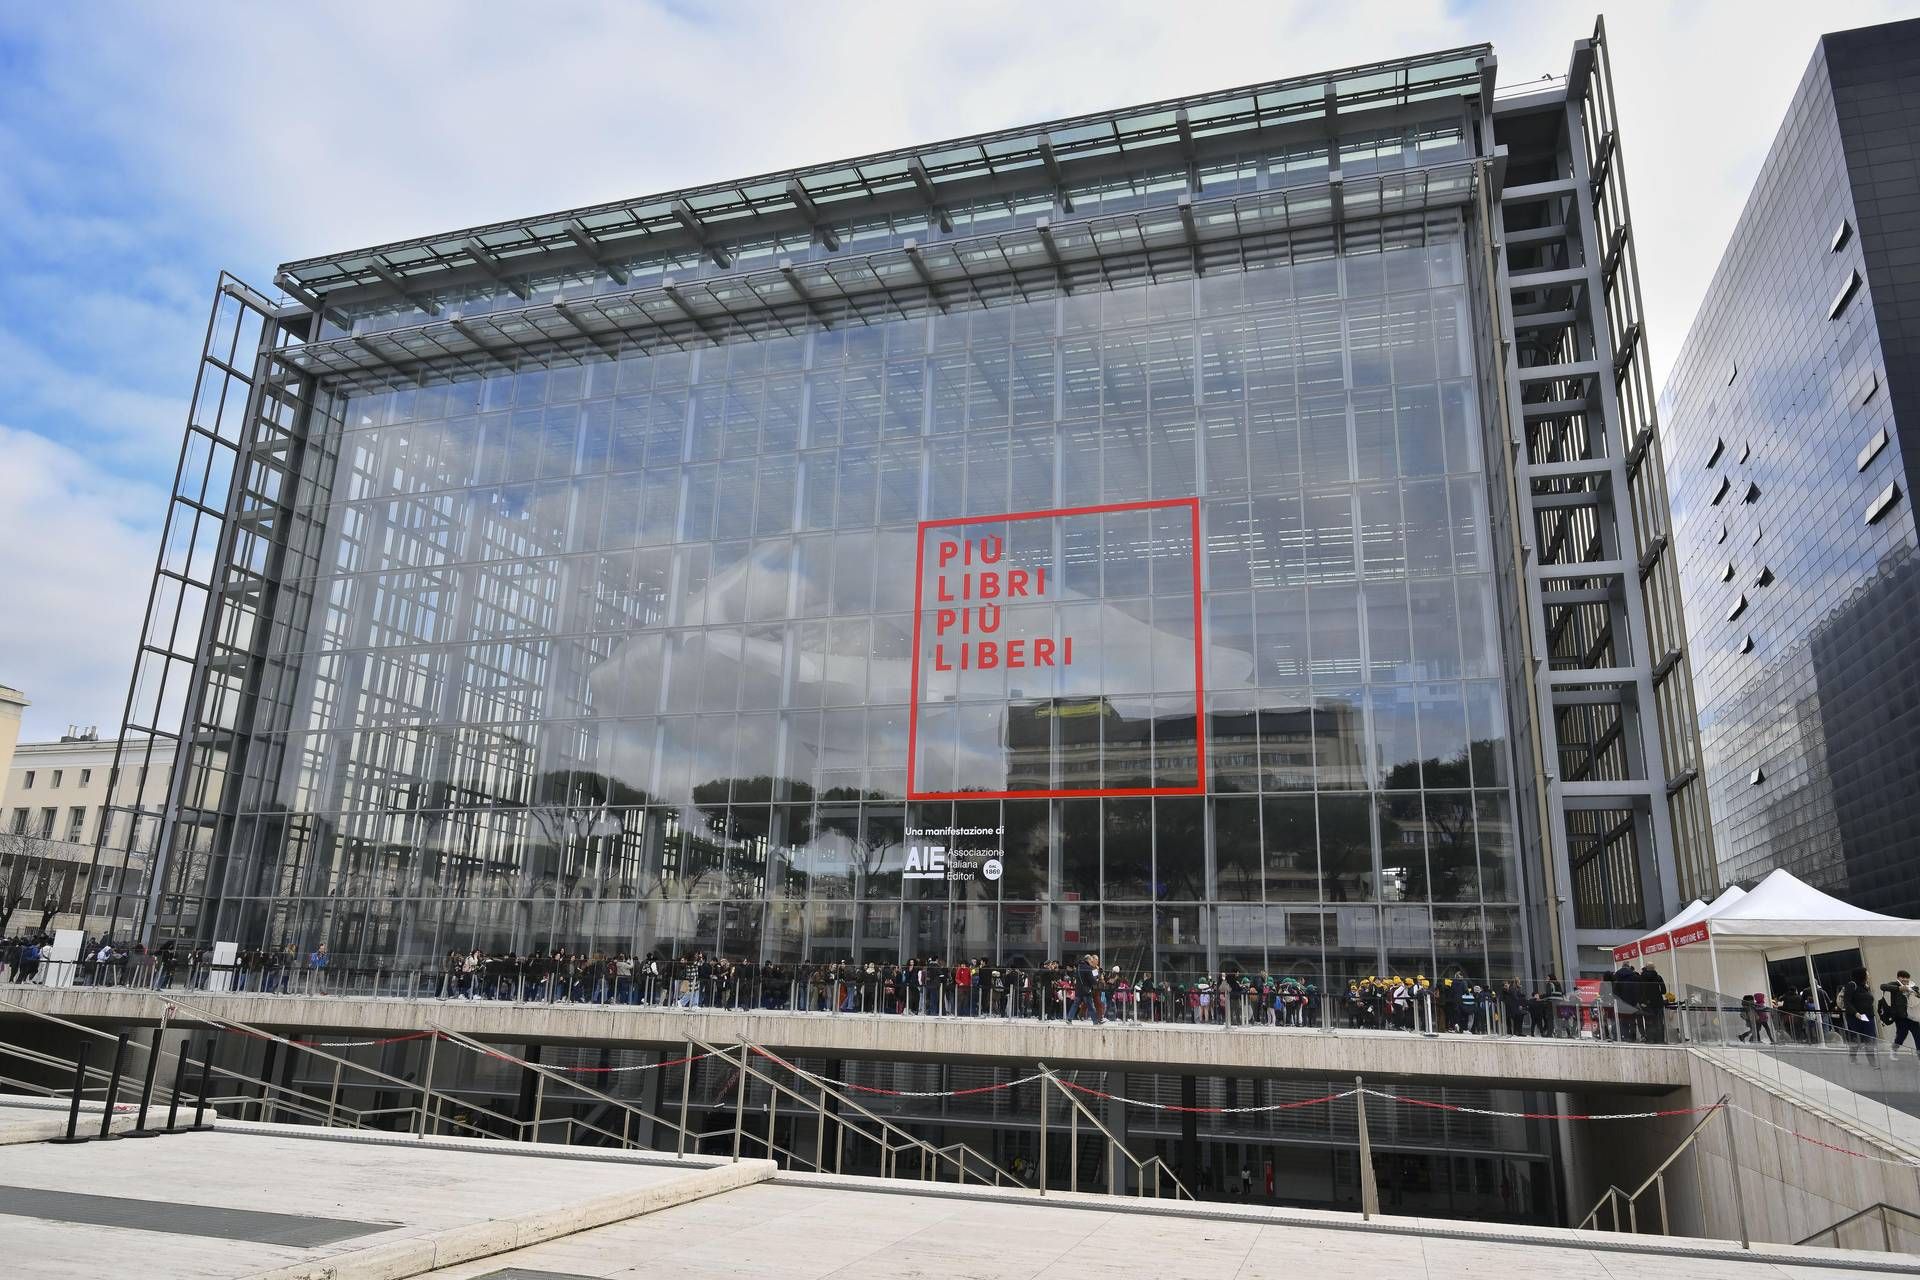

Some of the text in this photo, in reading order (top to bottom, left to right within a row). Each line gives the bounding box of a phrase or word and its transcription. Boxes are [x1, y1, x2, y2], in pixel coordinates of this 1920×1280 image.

[939, 534, 1002, 568] PIÙ
[938, 567, 1045, 601] LIBRI
[936, 602, 1001, 636] PIÙ
[935, 637, 1073, 671] LIBERI
[905, 825, 1005, 836] Una manifestazione di
[904, 846, 945, 871] AIE
[947, 848, 1005, 857] Associazione
[947, 860, 978, 868] Italiana
[985, 868, 1001, 876] 1869
[947, 871, 975, 881] Editori
